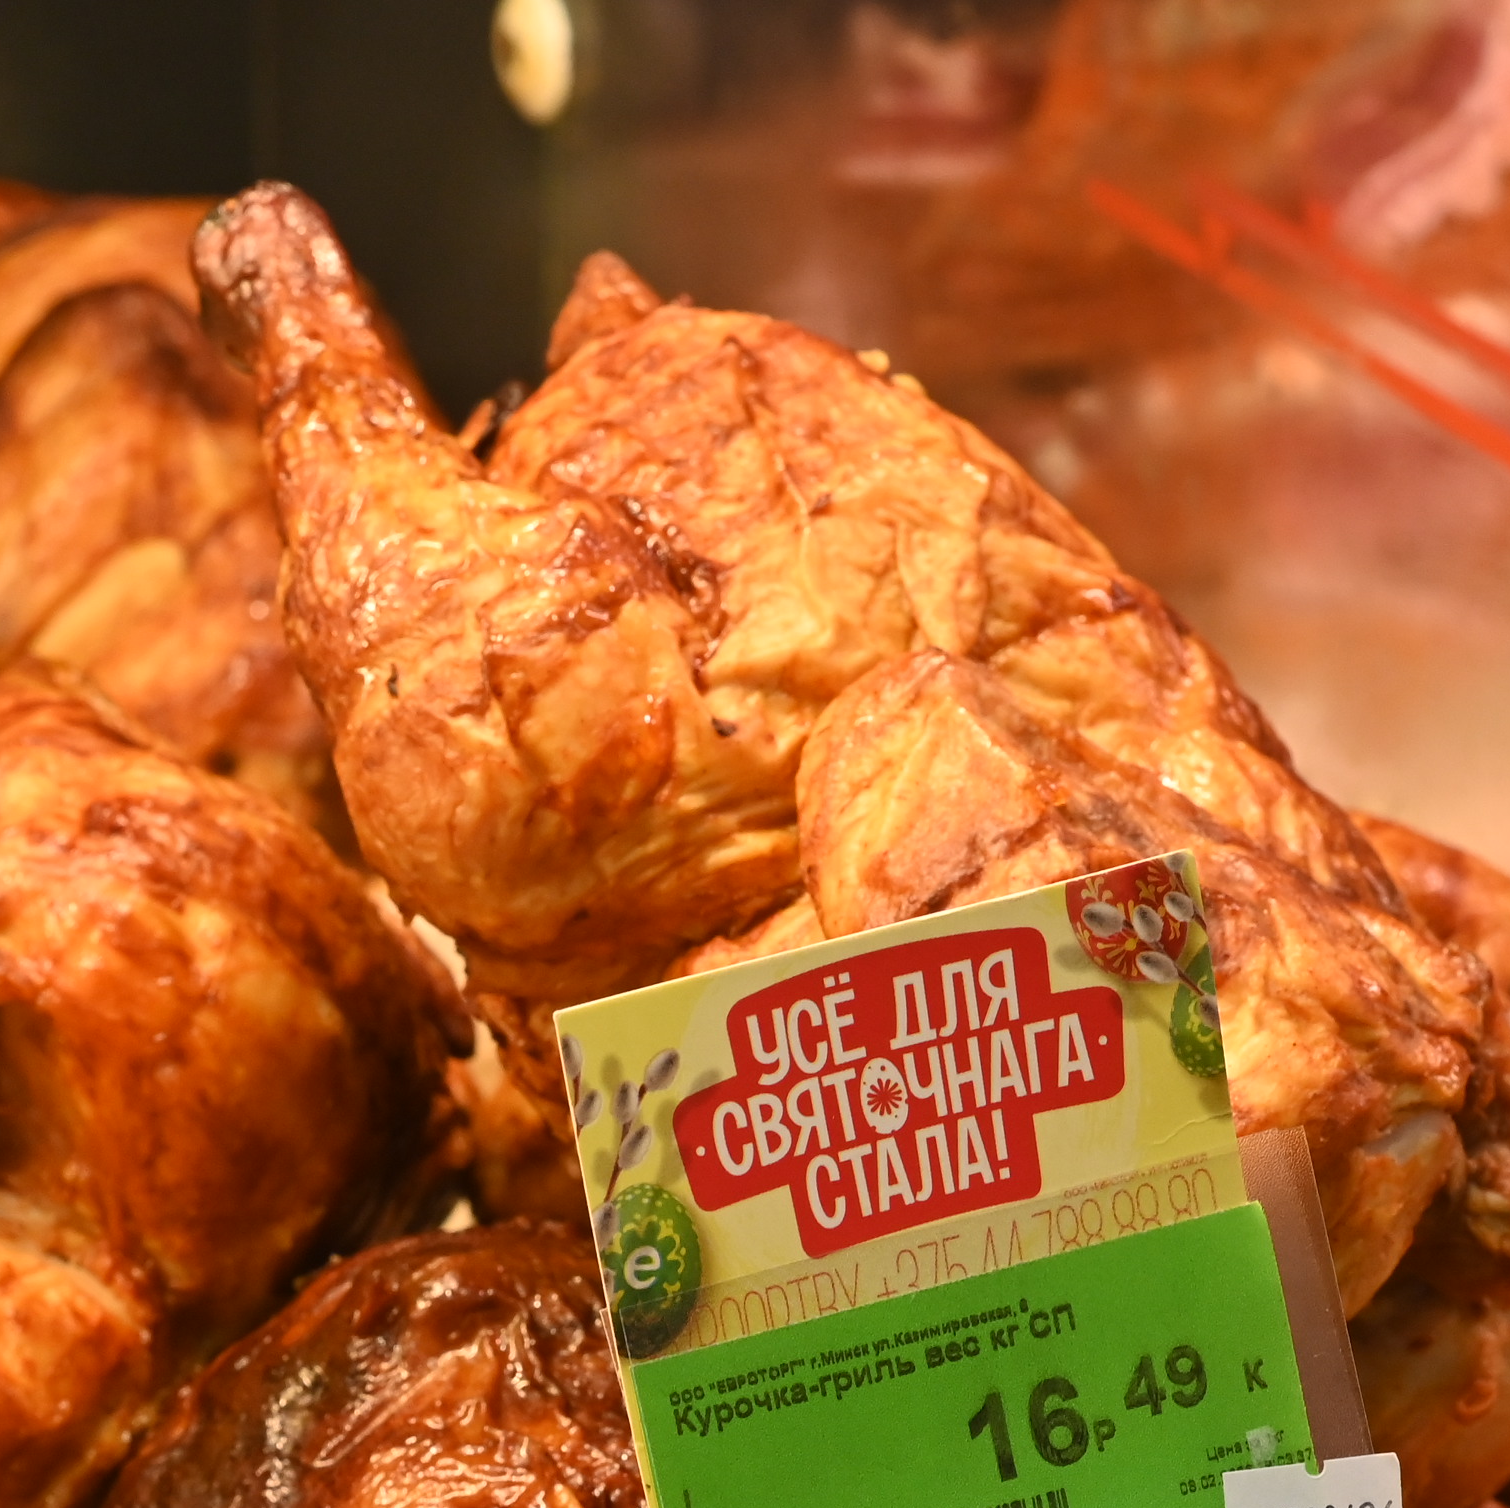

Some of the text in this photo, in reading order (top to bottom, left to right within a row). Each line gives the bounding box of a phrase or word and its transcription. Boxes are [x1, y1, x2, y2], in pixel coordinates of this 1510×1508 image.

[746, 948, 1020, 1086] УСЁ ДЛЯ
[805, 1109, 1011, 1230] СТАЛА!
[669, 1385, 705, 1407] ООО
[709, 1358, 805, 1395] "ЕВРОТОРГ"
[810, 1343, 869, 1369] г.Минск
[673, 1302, 1076, 1437] Курочка-гриль вес кг СП
[968, 1375, 1090, 1483] 16
[1123, 1344, 1209, 1417] 49
[1206, 1441, 1243, 1463] Цена
